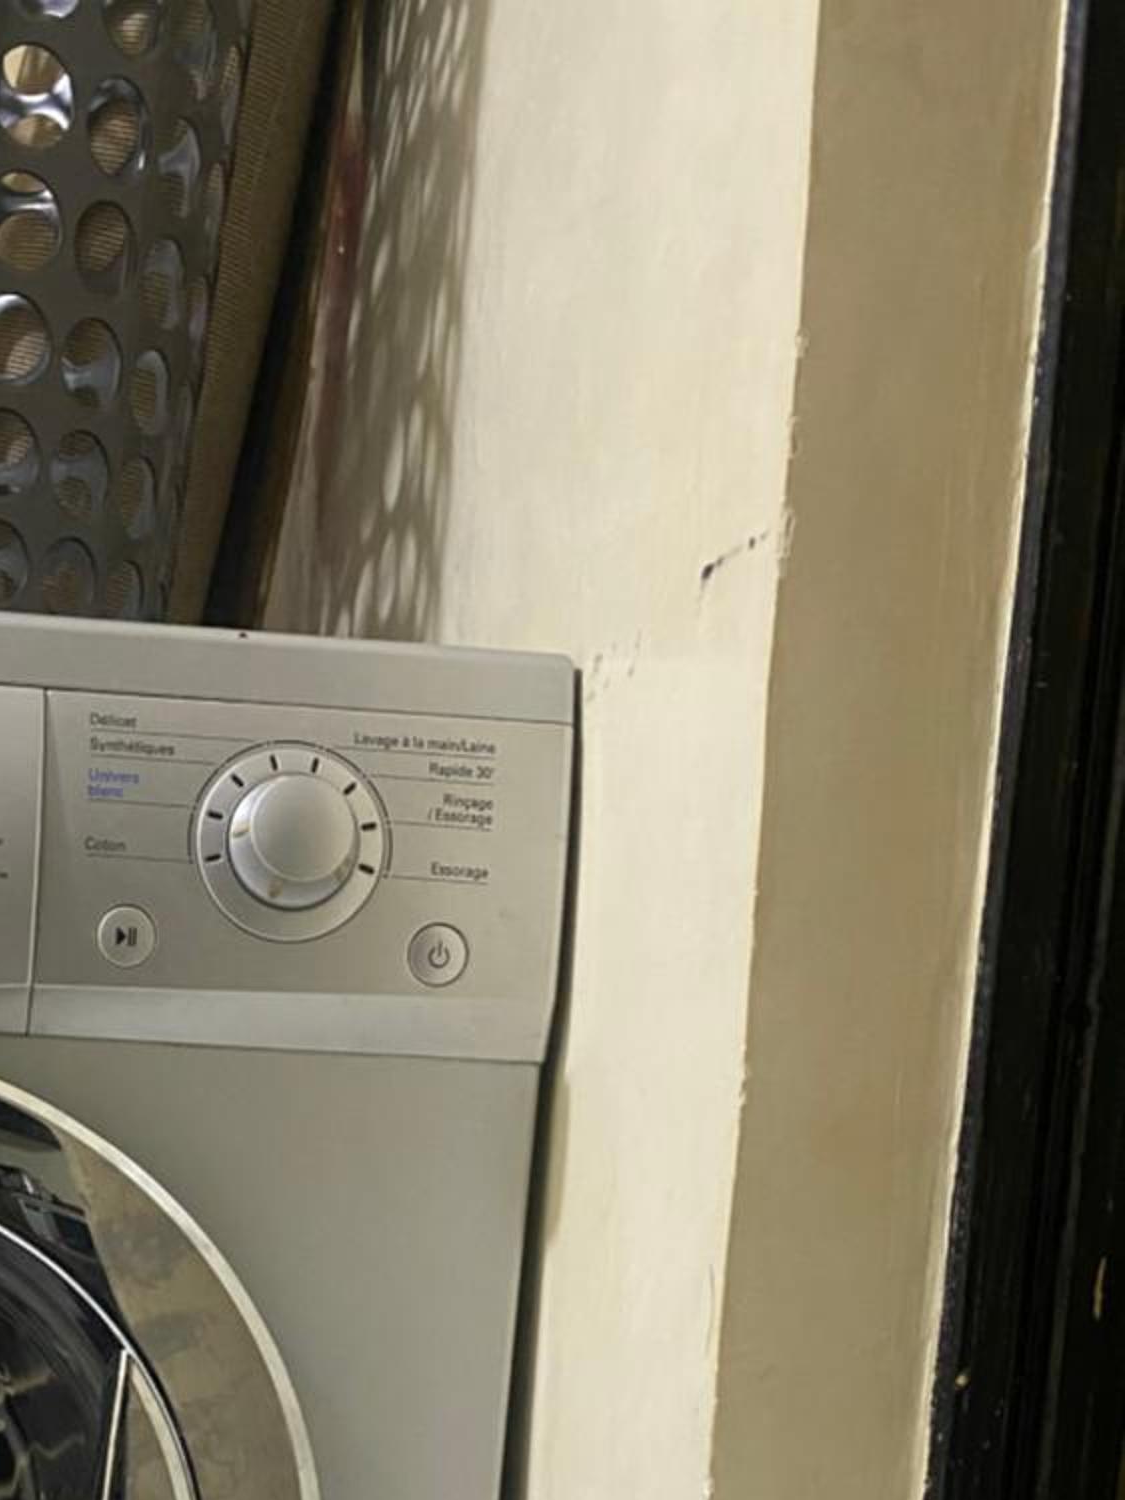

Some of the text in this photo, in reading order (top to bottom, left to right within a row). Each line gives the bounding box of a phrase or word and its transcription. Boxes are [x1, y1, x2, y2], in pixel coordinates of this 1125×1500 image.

[90, 711, 138, 728] Délicat
[90, 736, 176, 757] Synthétiques
[354, 732, 400, 750] Lavage
[413, 736, 424, 749] la
[427, 738, 497, 754] main/Laine
[88, 767, 140, 785] Univers
[429, 762, 474, 778] Rapide
[443, 793, 494, 811] Rinçage
[85, 835, 127, 851] Coton
[430, 861, 490, 881] Essorage
